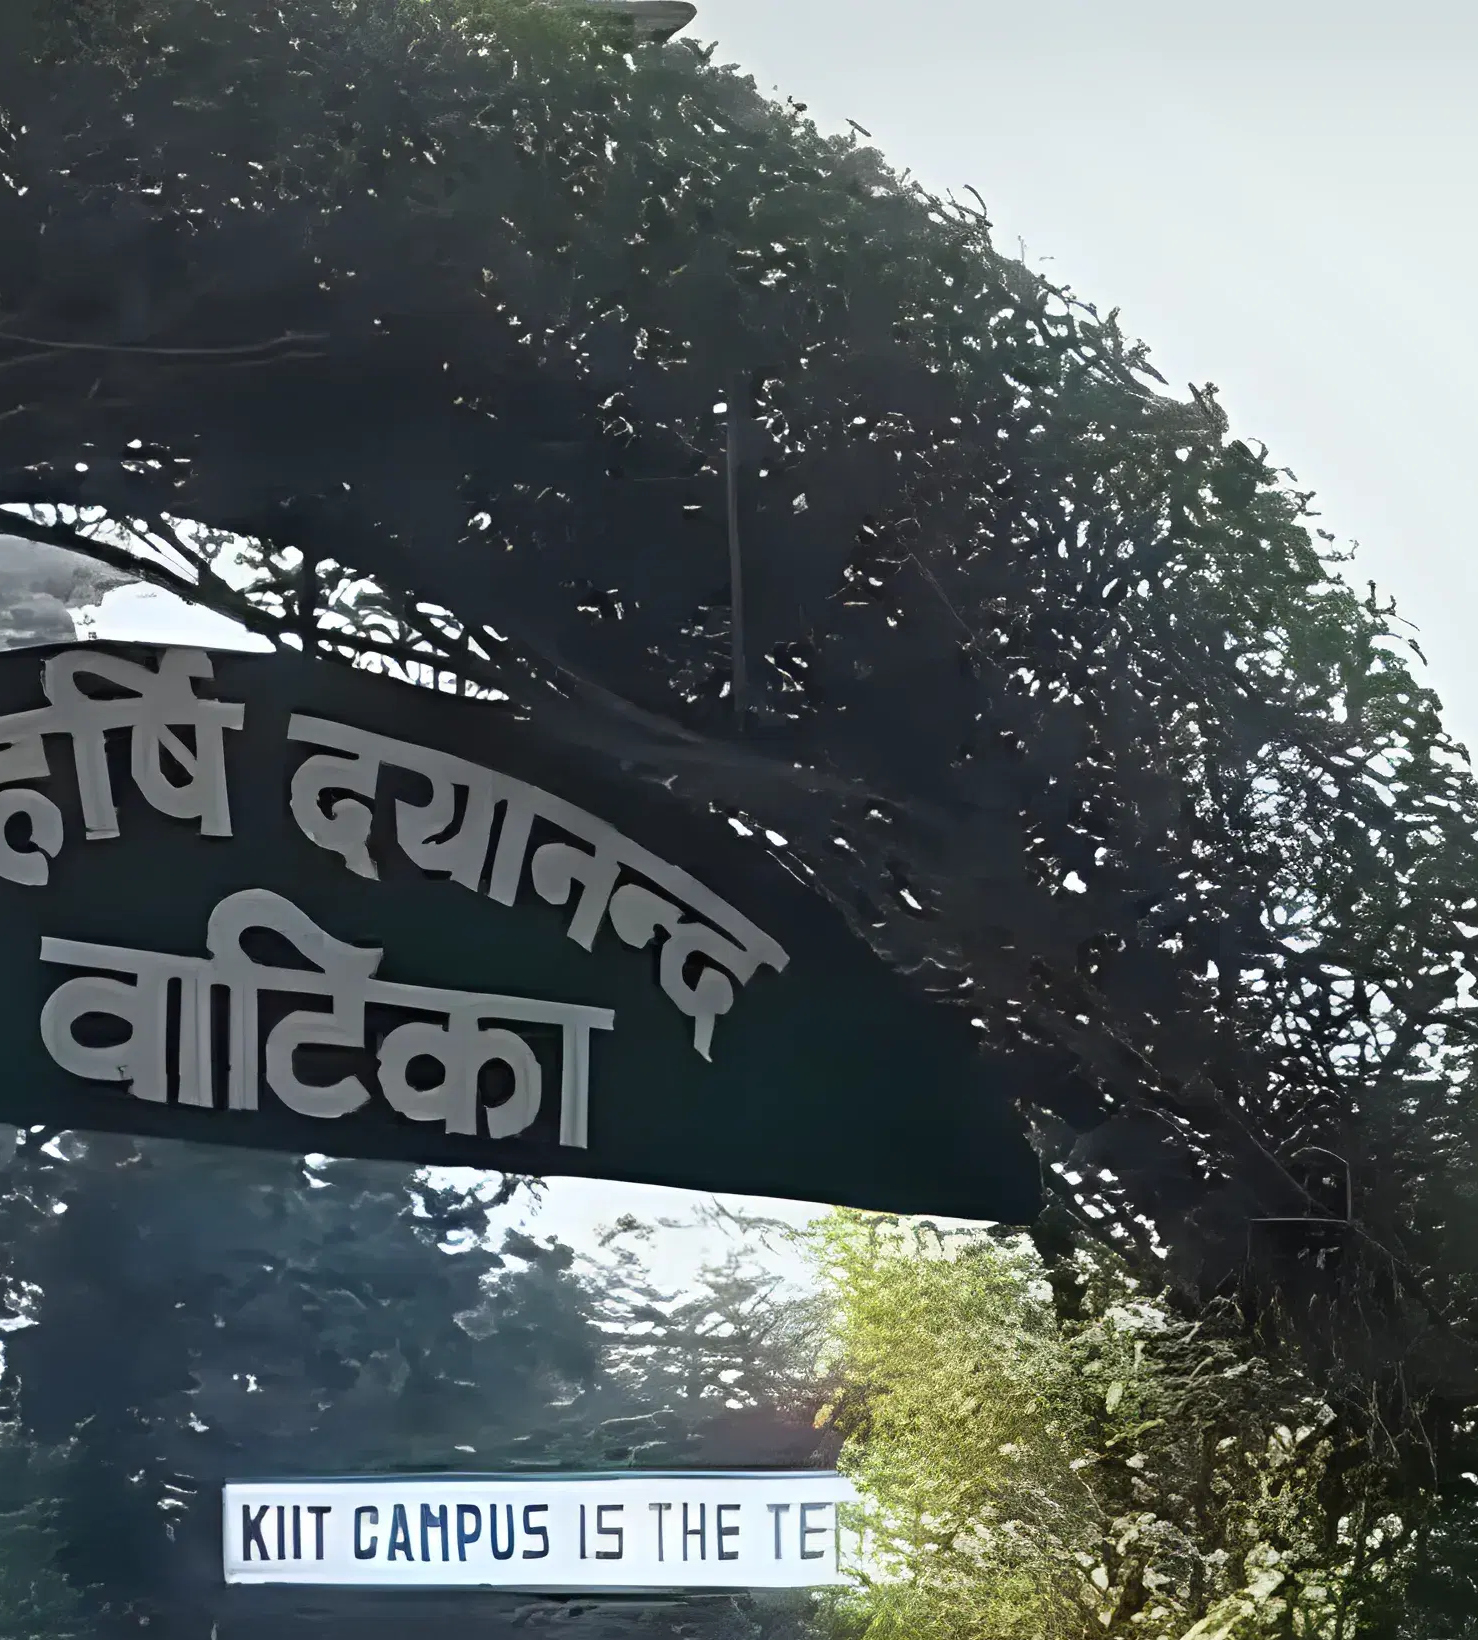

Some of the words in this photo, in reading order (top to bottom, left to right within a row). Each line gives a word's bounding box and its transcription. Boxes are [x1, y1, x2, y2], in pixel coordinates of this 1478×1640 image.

[287, 713, 791, 1062] दयानन्द
[40, 888, 615, 1149] वाटिका
[241, 1504, 332, 1562] KIIT
[353, 1503, 551, 1562] CAMPUS
[579, 1503, 624, 1561] IS
[649, 1502, 742, 1561] THE
[766, 1501, 841, 1561] TE
